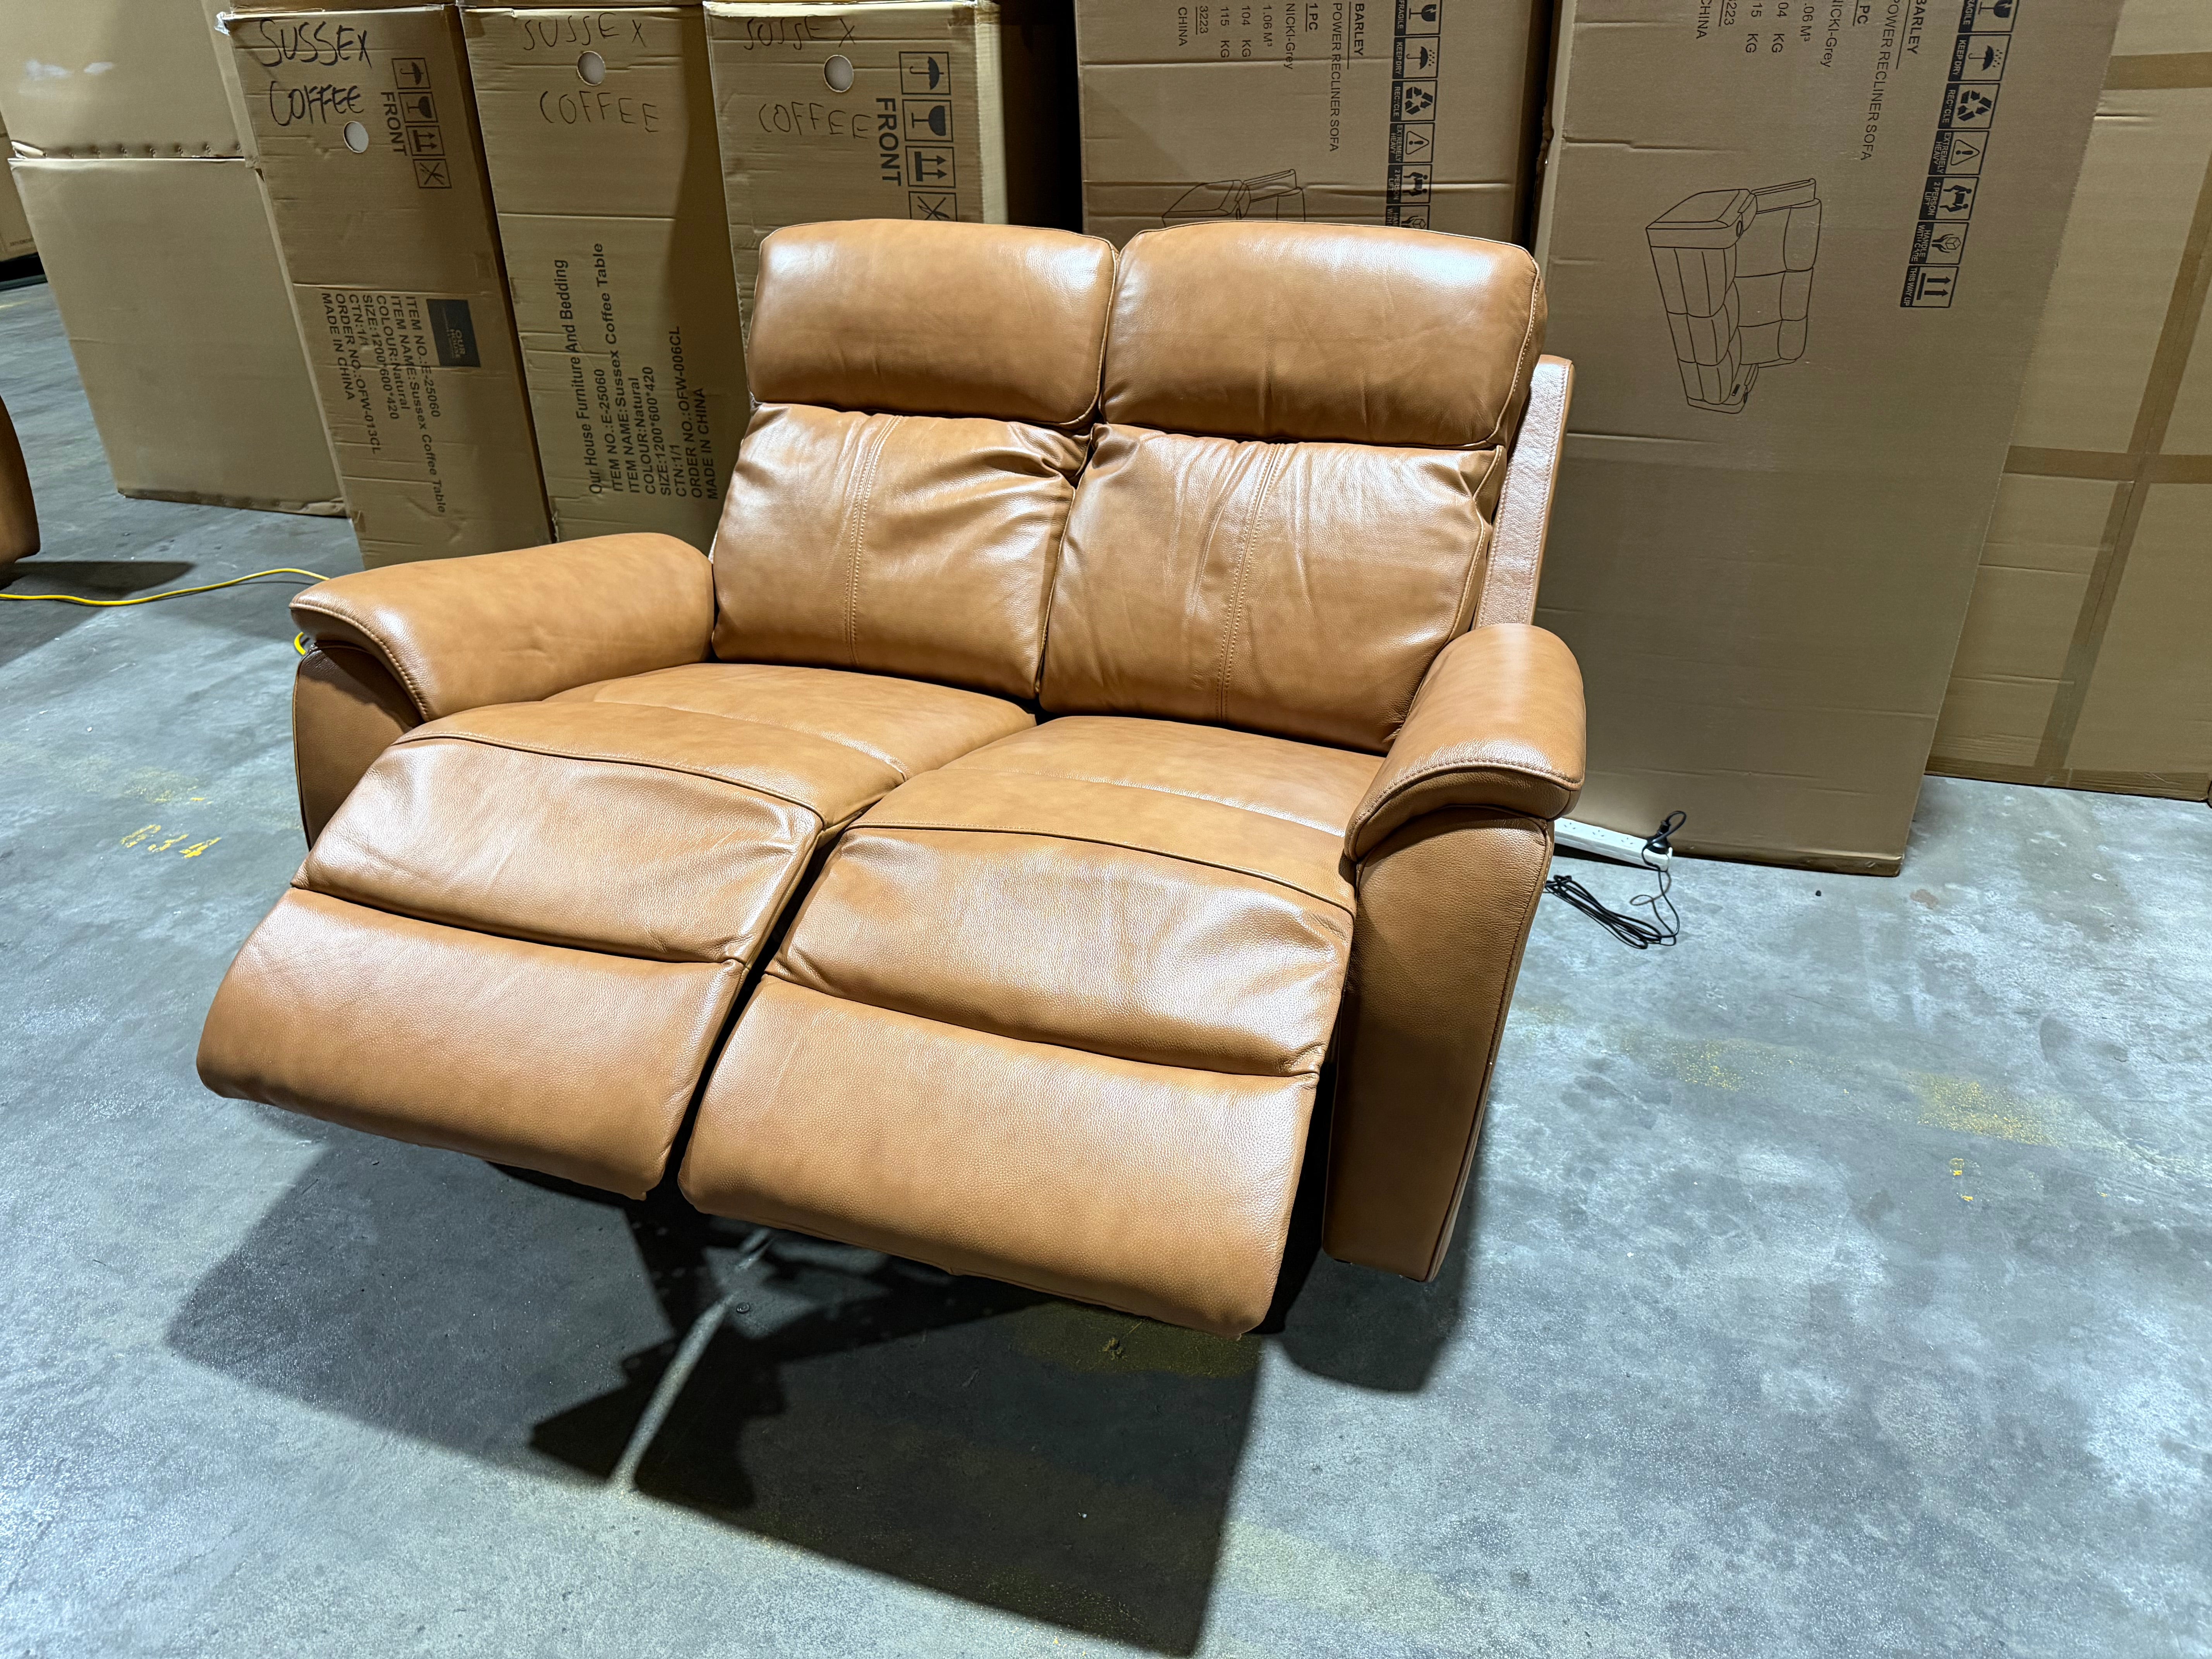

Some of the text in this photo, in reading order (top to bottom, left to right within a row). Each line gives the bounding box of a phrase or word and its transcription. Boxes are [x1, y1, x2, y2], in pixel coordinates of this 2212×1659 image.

[524, 12, 646, 50] SUSSEX
[1178, 7, 1188, 46] CHINA
[1199, 6, 1209, 34] 3223
[1221, 7, 1230, 58] 115 KG
[1242, 6, 1251, 57] 104 KG
[1263, 5, 1273, 29] 1.06
[1284, 3, 1295, 69] NICKI-Grey
[1309, 13, 1318, 30] PC
[1354, 3, 1365, 56] BARLEY
[1724, 0, 1737, 25] 223
[1745, 3, 1763, 53] 15 KG
[1772, 2, 1788, 53] 04 KG
[1820, 0, 1843, 67] ICKI-Grey
[1857, 5, 1870, 24] PC
[259, 18, 372, 69] SUSSEX
[1953, 40, 1966, 75] KEEP DRY
[1330, 3, 1342, 152] POWER RECLINER SOFA
[1868, 52, 1891, 121] RECLINER
[270, 81, 364, 126] COFFEE
[381, 91, 407, 156] FRONT
[540, 91, 659, 132] COFFEE
[759, 101, 871, 139] COFFEE
[876, 98, 902, 186] FRONT
[1395, 125, 1403, 162] EXTREMELY
[1861, 124, 1877, 160] SOFA
[1937, 132, 1952, 174] EXTREMELY
[1927, 187, 1940, 216] PERSON
[1919, 229, 1931, 258] HANDLE
[1904, 267, 1918, 306] THIS WAY UP
[349, 294, 369, 345] CTN:1/1
[321, 293, 355, 400] MADE IN CHINA
[377, 295, 410, 409] COLOUR:Natural
[406, 297, 441, 417] ITEM NO.:E-25060
[593, 243, 640, 493] ITEM NAME:Sussex Coffee Table
[335, 294, 381, 454] ORDER NO.:OFW-013CL
[554, 260, 602, 494] Our House Furniture And Bedding
[391, 296, 446, 513] ITEM NAME:Sussex Coffee Table
[594, 369, 623, 491] ITEM NO.:E-25060
[669, 326, 702, 498] ORDER NO.:OFW-006CL
[628, 378, 656, 494] COLOUR:Natural
[693, 388, 718, 499] MADE IN CHINA
[669, 445, 687, 497] CTN:1/1
